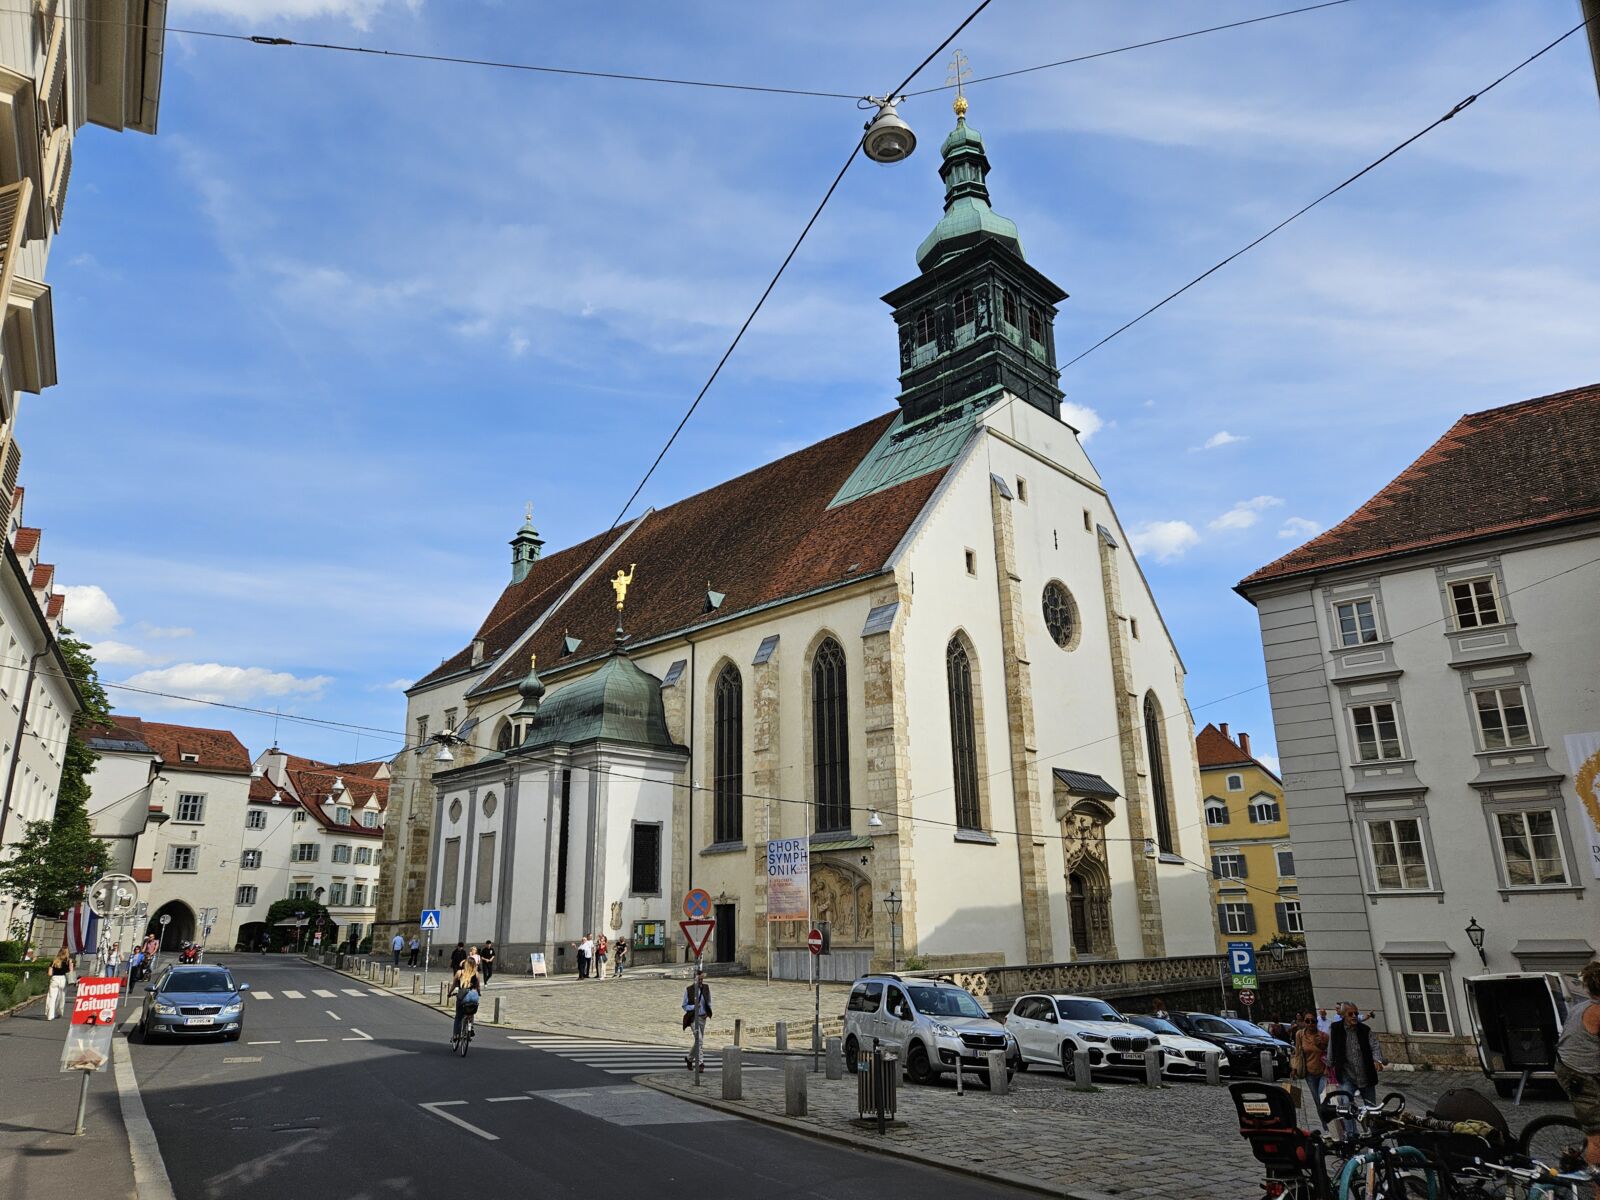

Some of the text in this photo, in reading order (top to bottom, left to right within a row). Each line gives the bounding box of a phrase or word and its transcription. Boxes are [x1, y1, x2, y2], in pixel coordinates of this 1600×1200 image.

[769, 852, 808, 864] SYMPH
[768, 864, 797, 876] ONIK
[1232, 950, 1250, 973] P
[77, 982, 120, 997] Kronen
[75, 997, 119, 1011] Zeitung
